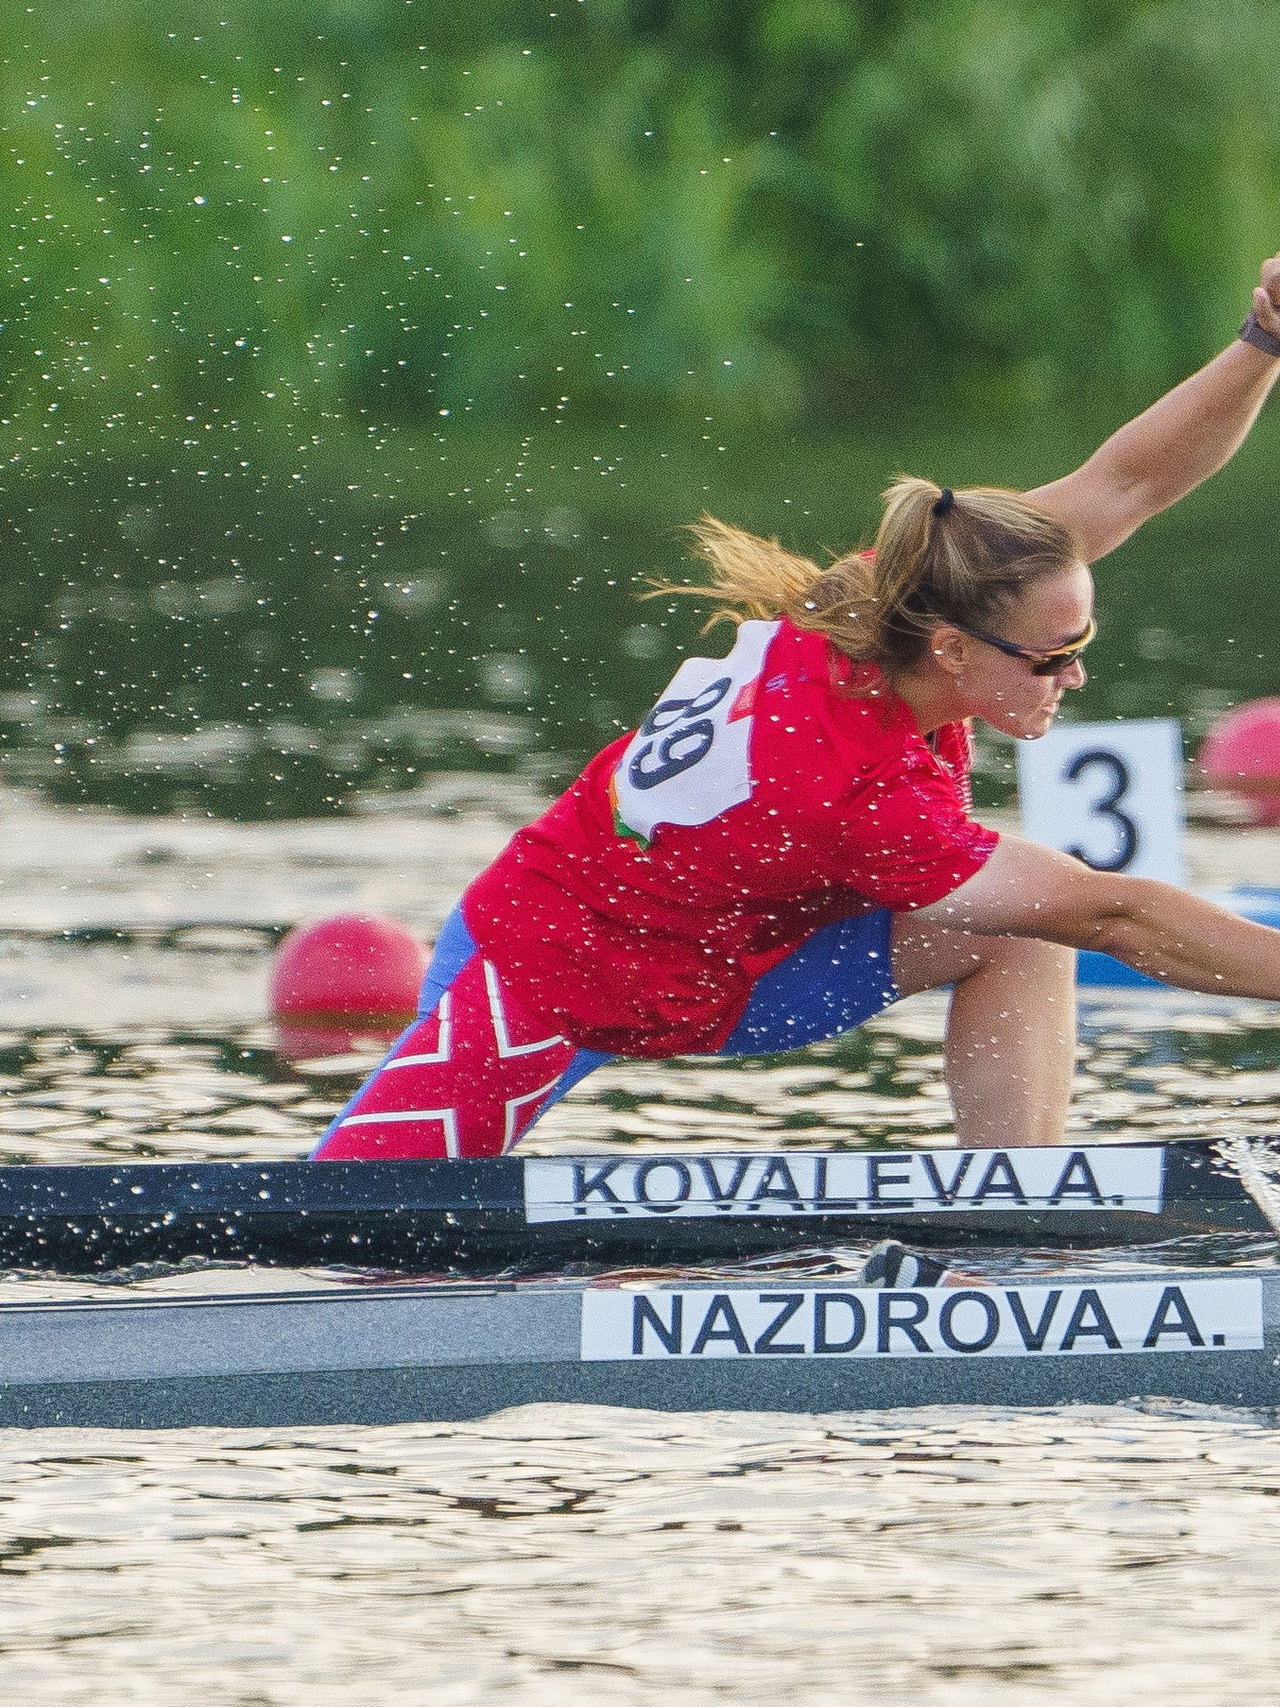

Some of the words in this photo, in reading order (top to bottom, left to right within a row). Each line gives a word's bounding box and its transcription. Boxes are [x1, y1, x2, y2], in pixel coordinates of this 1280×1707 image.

[1063, 747, 1136, 872] 3
[571, 1151, 1028, 1215] KOVALEVA
[1047, 1151, 1124, 1207] A.
[632, 1289, 1122, 1355] NAZDROVA
[1143, 1286, 1226, 1348] A.
